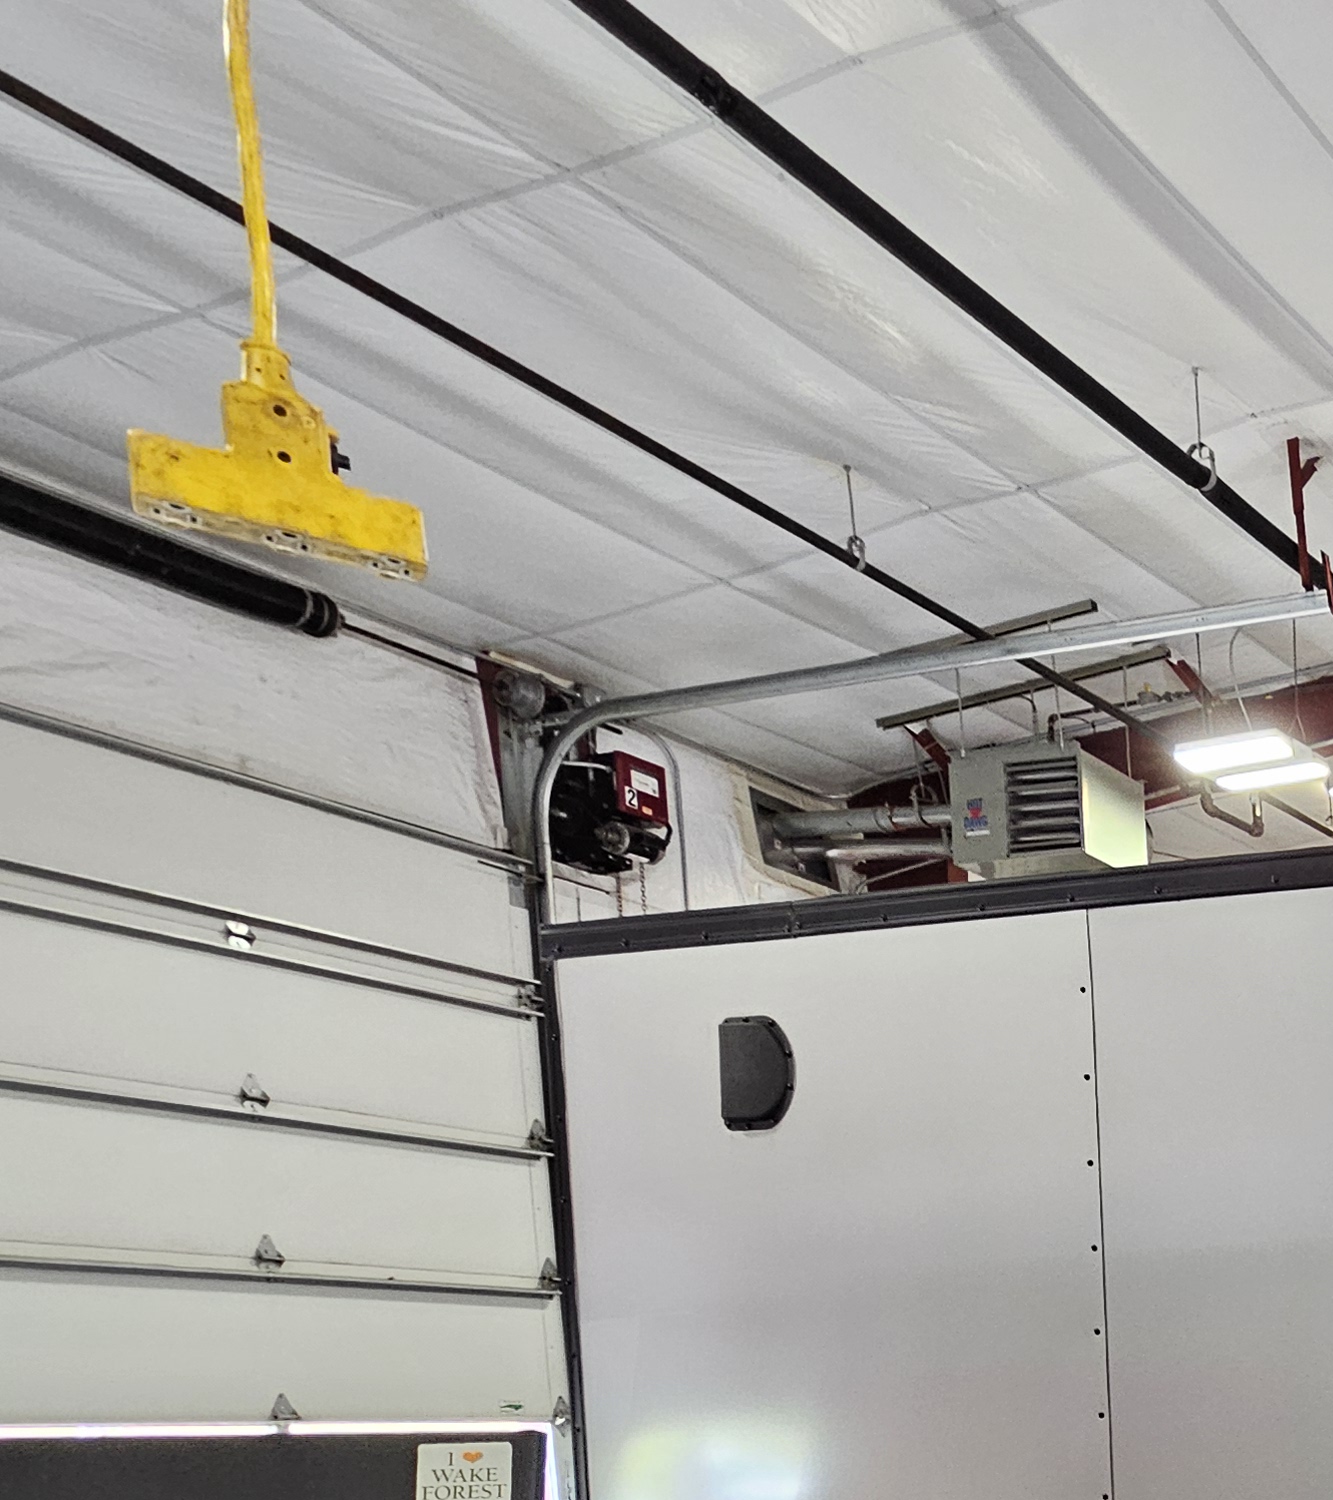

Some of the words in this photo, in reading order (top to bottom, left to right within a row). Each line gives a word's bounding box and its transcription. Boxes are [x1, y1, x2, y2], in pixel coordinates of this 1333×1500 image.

[627, 789, 636, 807] 2
[448, 1452, 454, 1466] I
[432, 1467, 498, 1482] WAKE
[421, 1484, 507, 1500] FOREST
